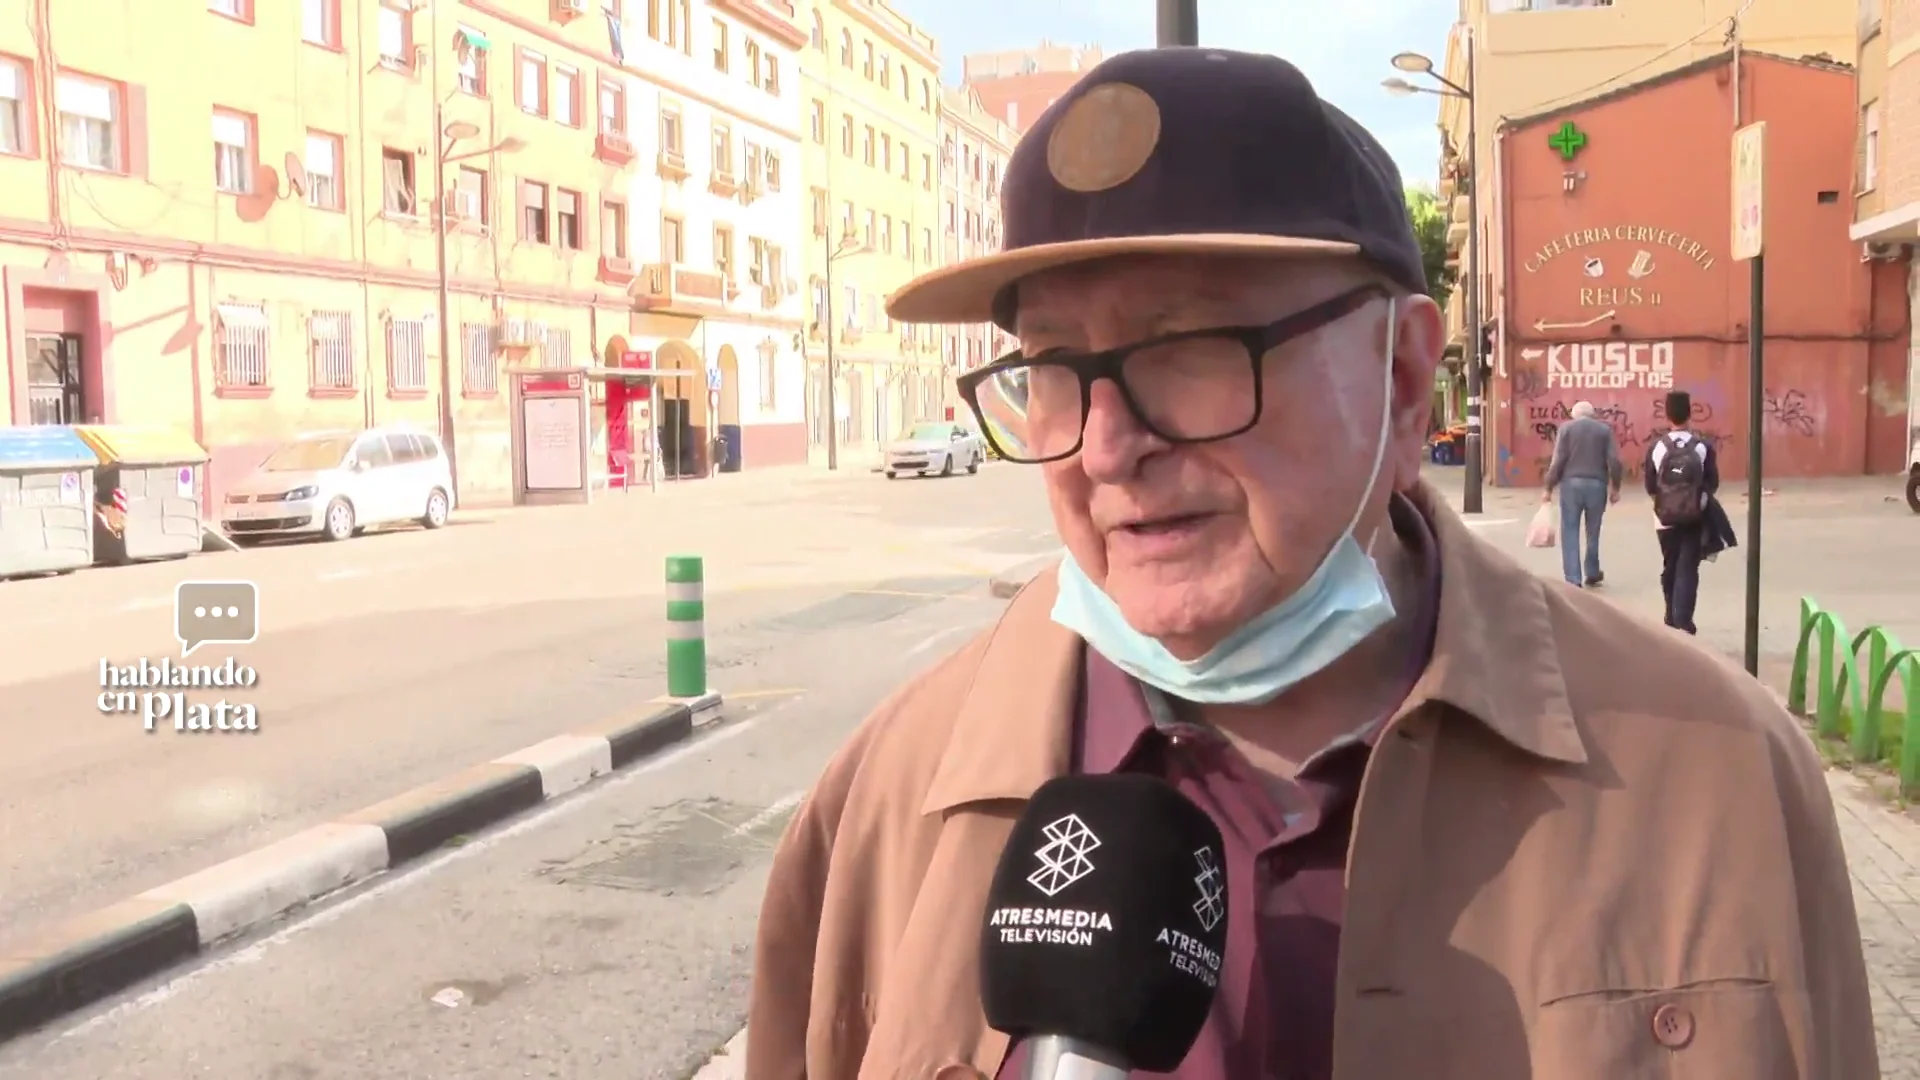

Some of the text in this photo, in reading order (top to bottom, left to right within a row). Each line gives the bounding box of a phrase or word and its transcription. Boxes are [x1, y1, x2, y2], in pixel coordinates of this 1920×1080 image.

[1525, 224, 1716, 272] CAFETERIA CERVECERIA
[1580, 287, 1643, 306] REUS
[1548, 342, 1674, 373] KIOSCO
[990, 908, 1113, 931] ATRESMEDIA
[1000, 927, 1093, 946] TELEVISIÓN
